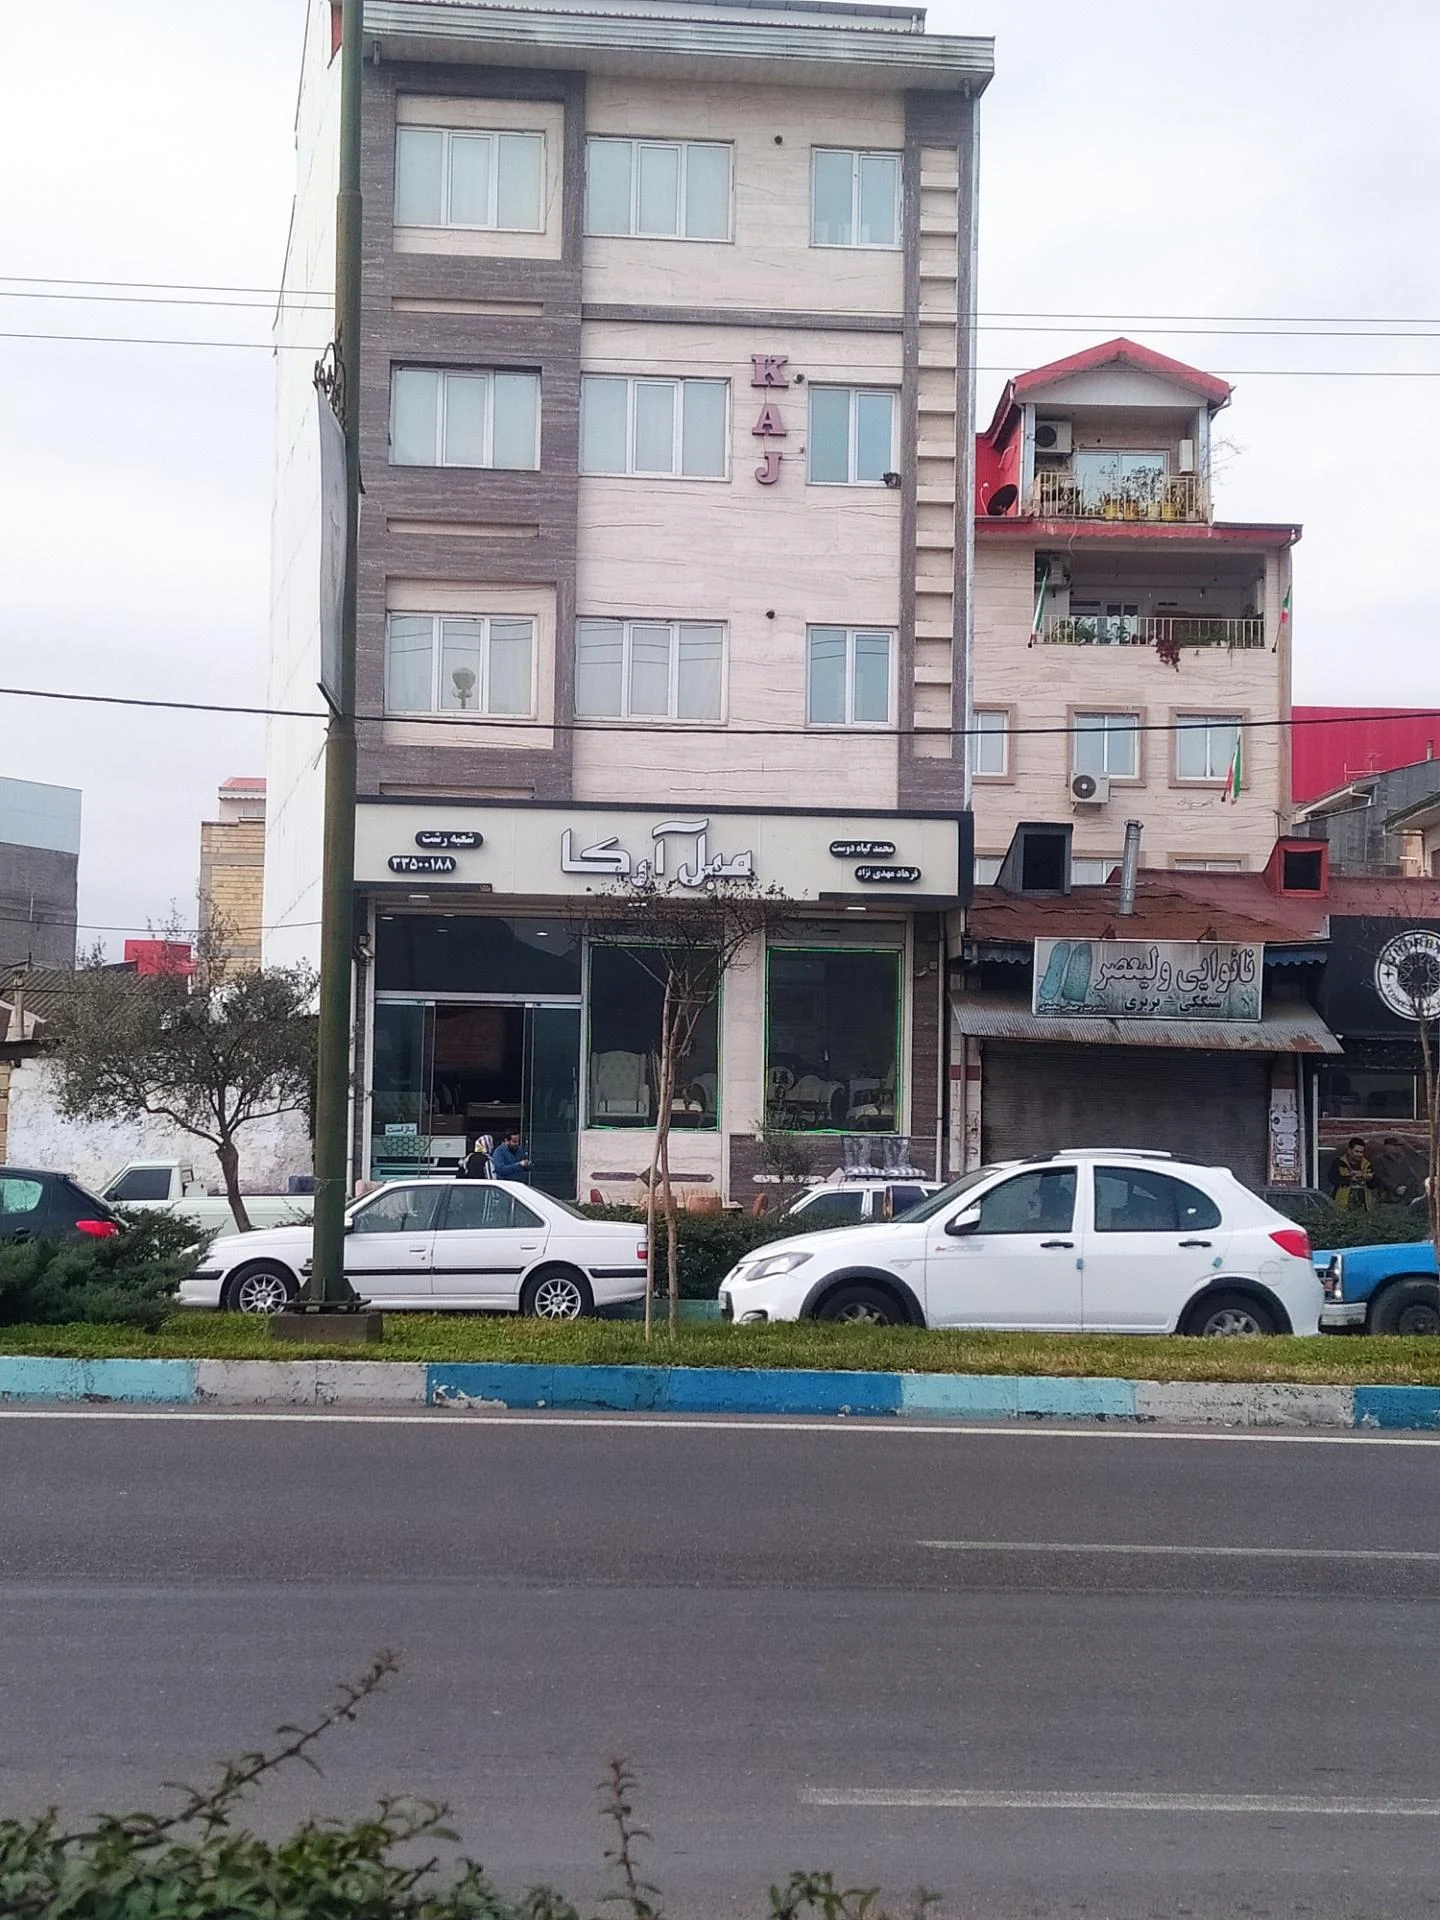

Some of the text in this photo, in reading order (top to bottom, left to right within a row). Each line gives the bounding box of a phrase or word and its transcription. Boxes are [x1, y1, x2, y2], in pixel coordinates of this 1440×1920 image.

[421, 832, 475, 847] شعبه رشت
[831, 844, 855, 855] دوست
[872, 845, 894, 853] محمد
[392, 857, 453, 871] ۳۳۵۰۰۱۸۸
[677, 832, 753, 889] مبل
[872, 870, 895, 880] مهدی
[896, 868, 919, 881] فرهاد
[1093, 945, 1256, 994] نانوایی ولیعصر
[1124, 996, 1161, 1012] بربری
